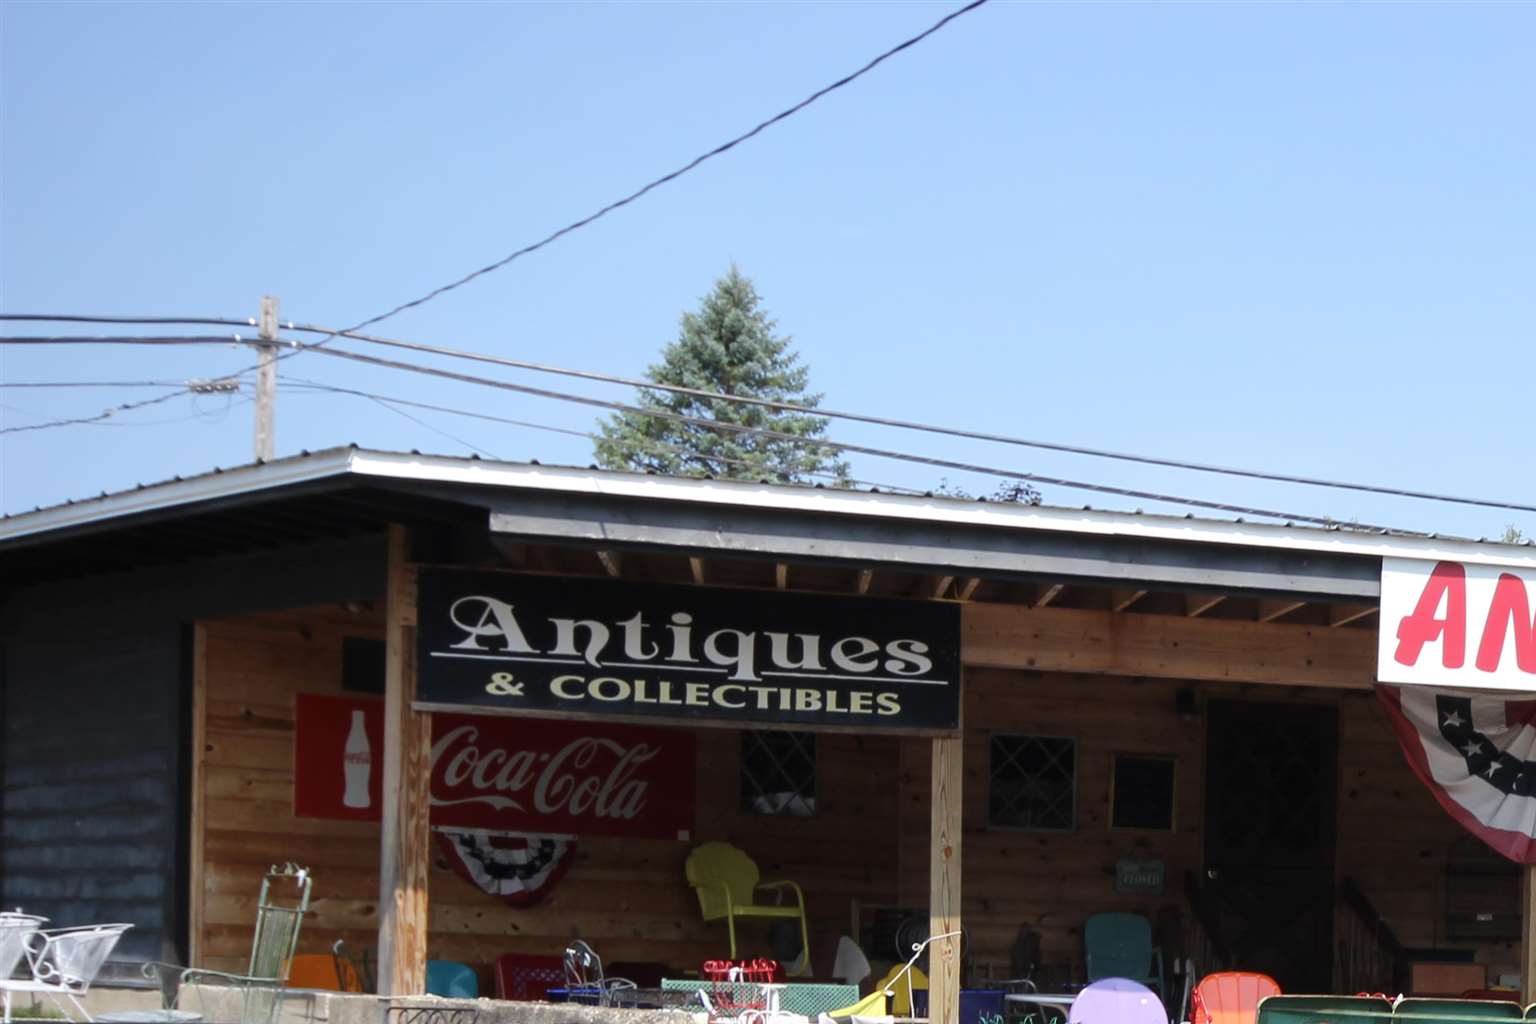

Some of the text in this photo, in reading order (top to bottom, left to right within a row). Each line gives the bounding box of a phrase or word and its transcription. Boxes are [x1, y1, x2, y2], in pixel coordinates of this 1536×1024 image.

[450, 596, 933, 681] Antiques
[486, 672, 902, 716] & COLLECTIBLES
